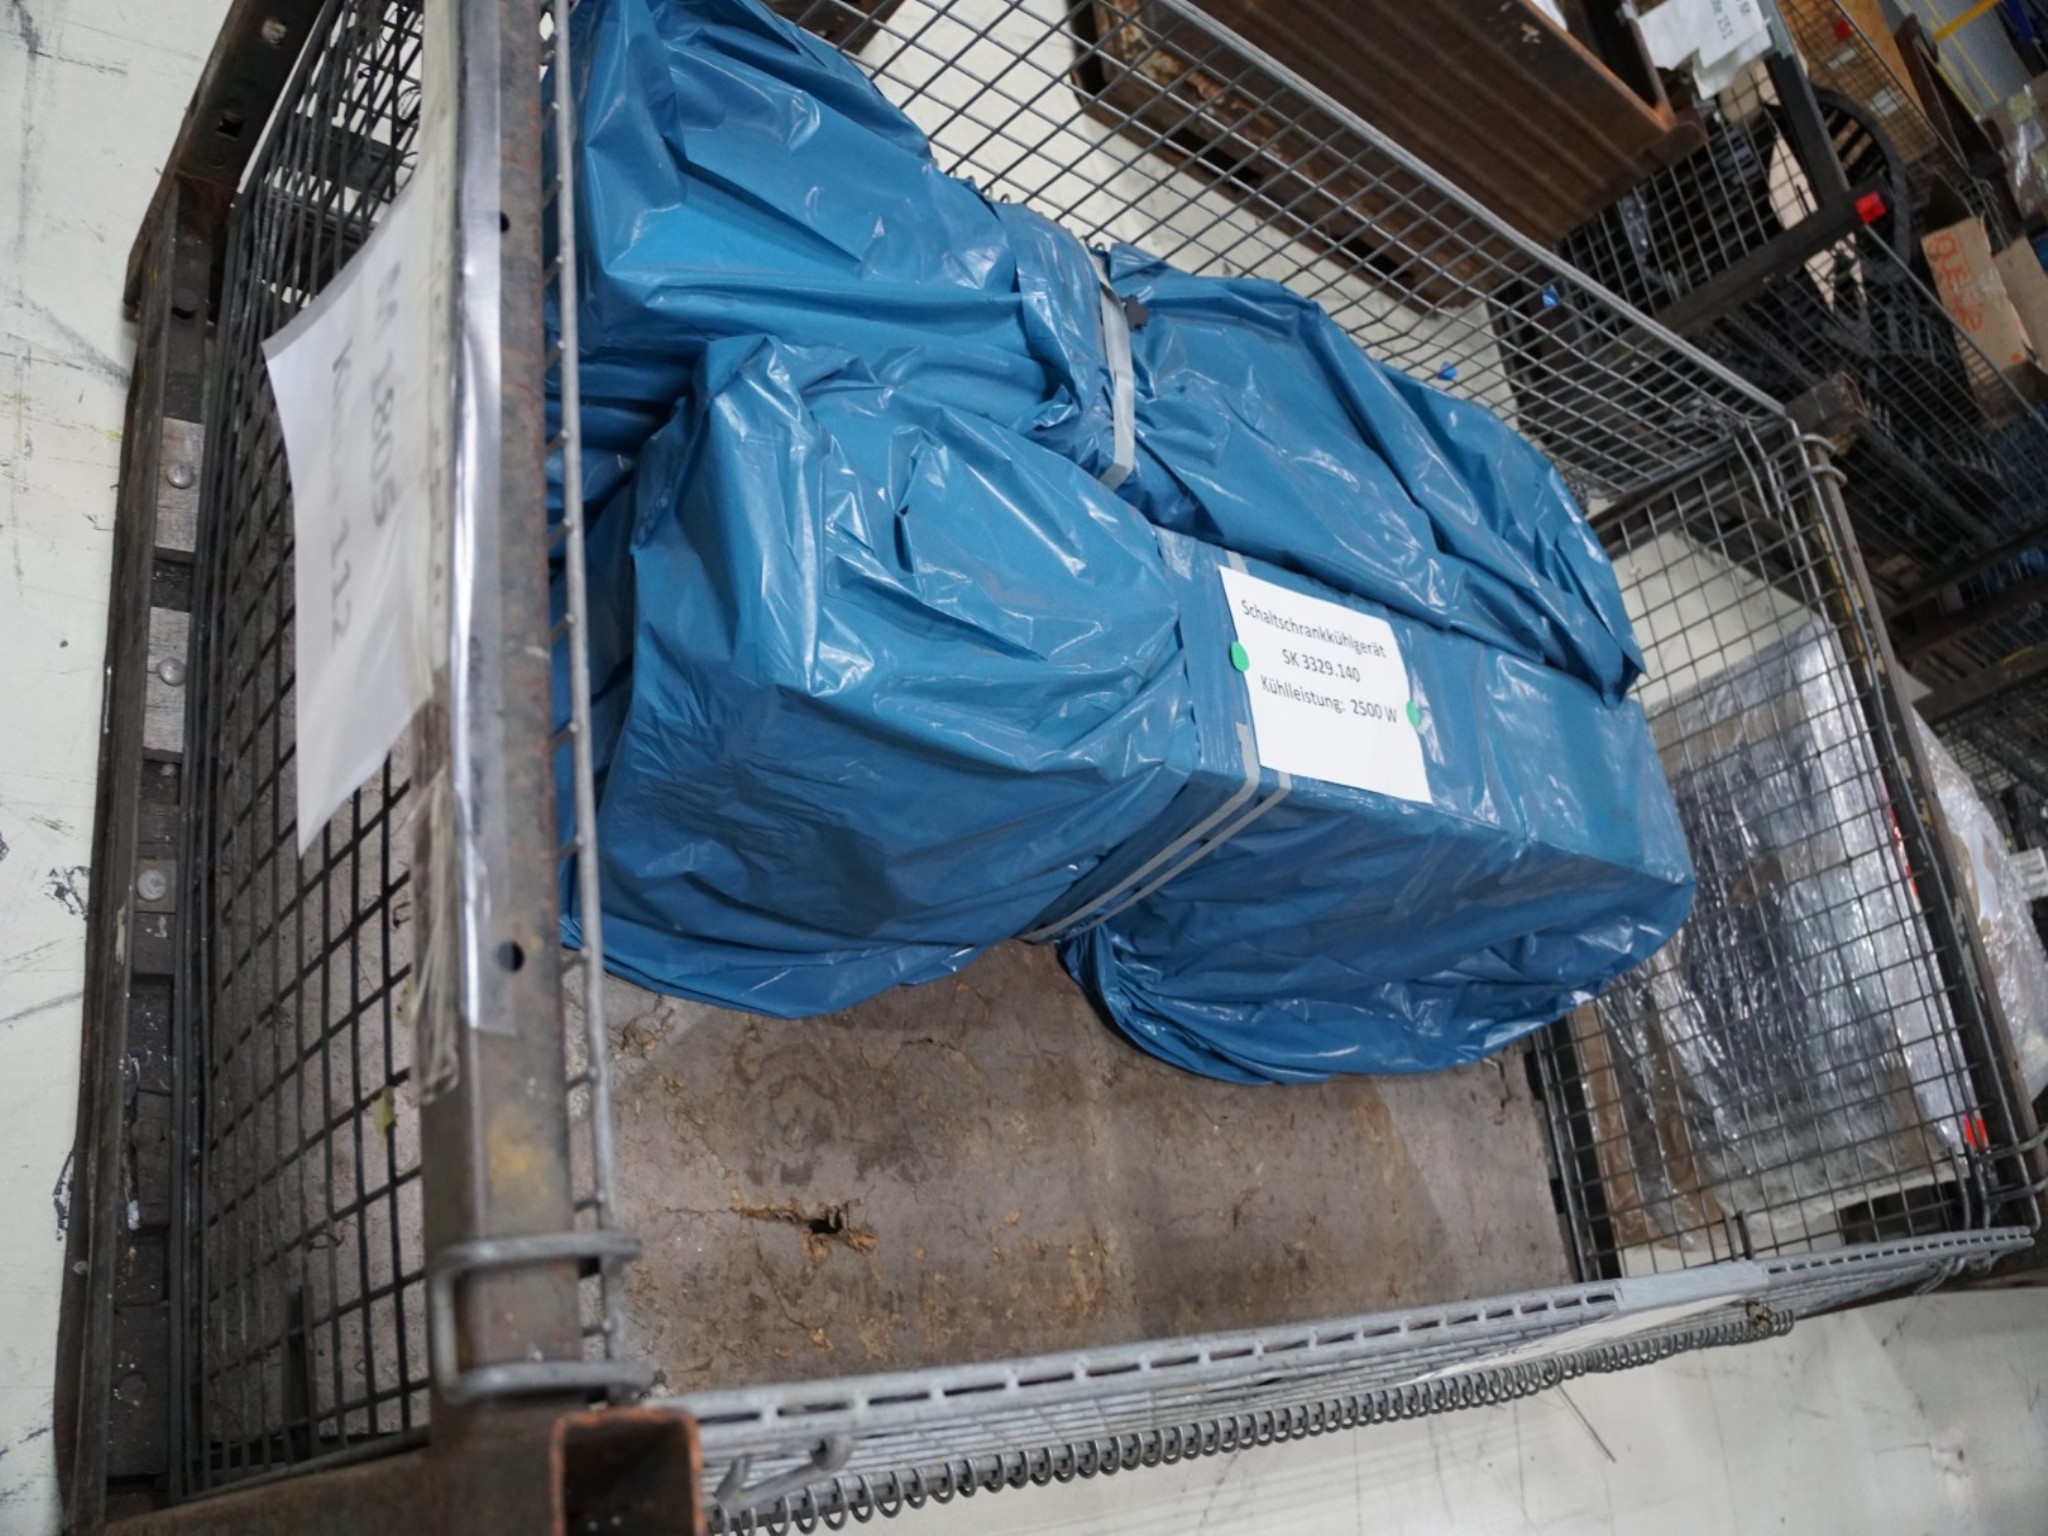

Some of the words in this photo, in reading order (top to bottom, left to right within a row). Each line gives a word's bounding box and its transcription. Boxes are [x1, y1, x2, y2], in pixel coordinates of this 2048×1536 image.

[370, 347, 399, 529] 1805
[329, 517, 353, 653] 112
[1241, 599, 1387, 658] Schaltschrankkühlgerät
[1281, 649, 1300, 668] SK
[1301, 653, 1361, 683] 3329.140
[1260, 674, 1346, 714] Kühlleistung:
[1350, 698, 1383, 719] 2500
[1384, 706, 1398, 724] W
